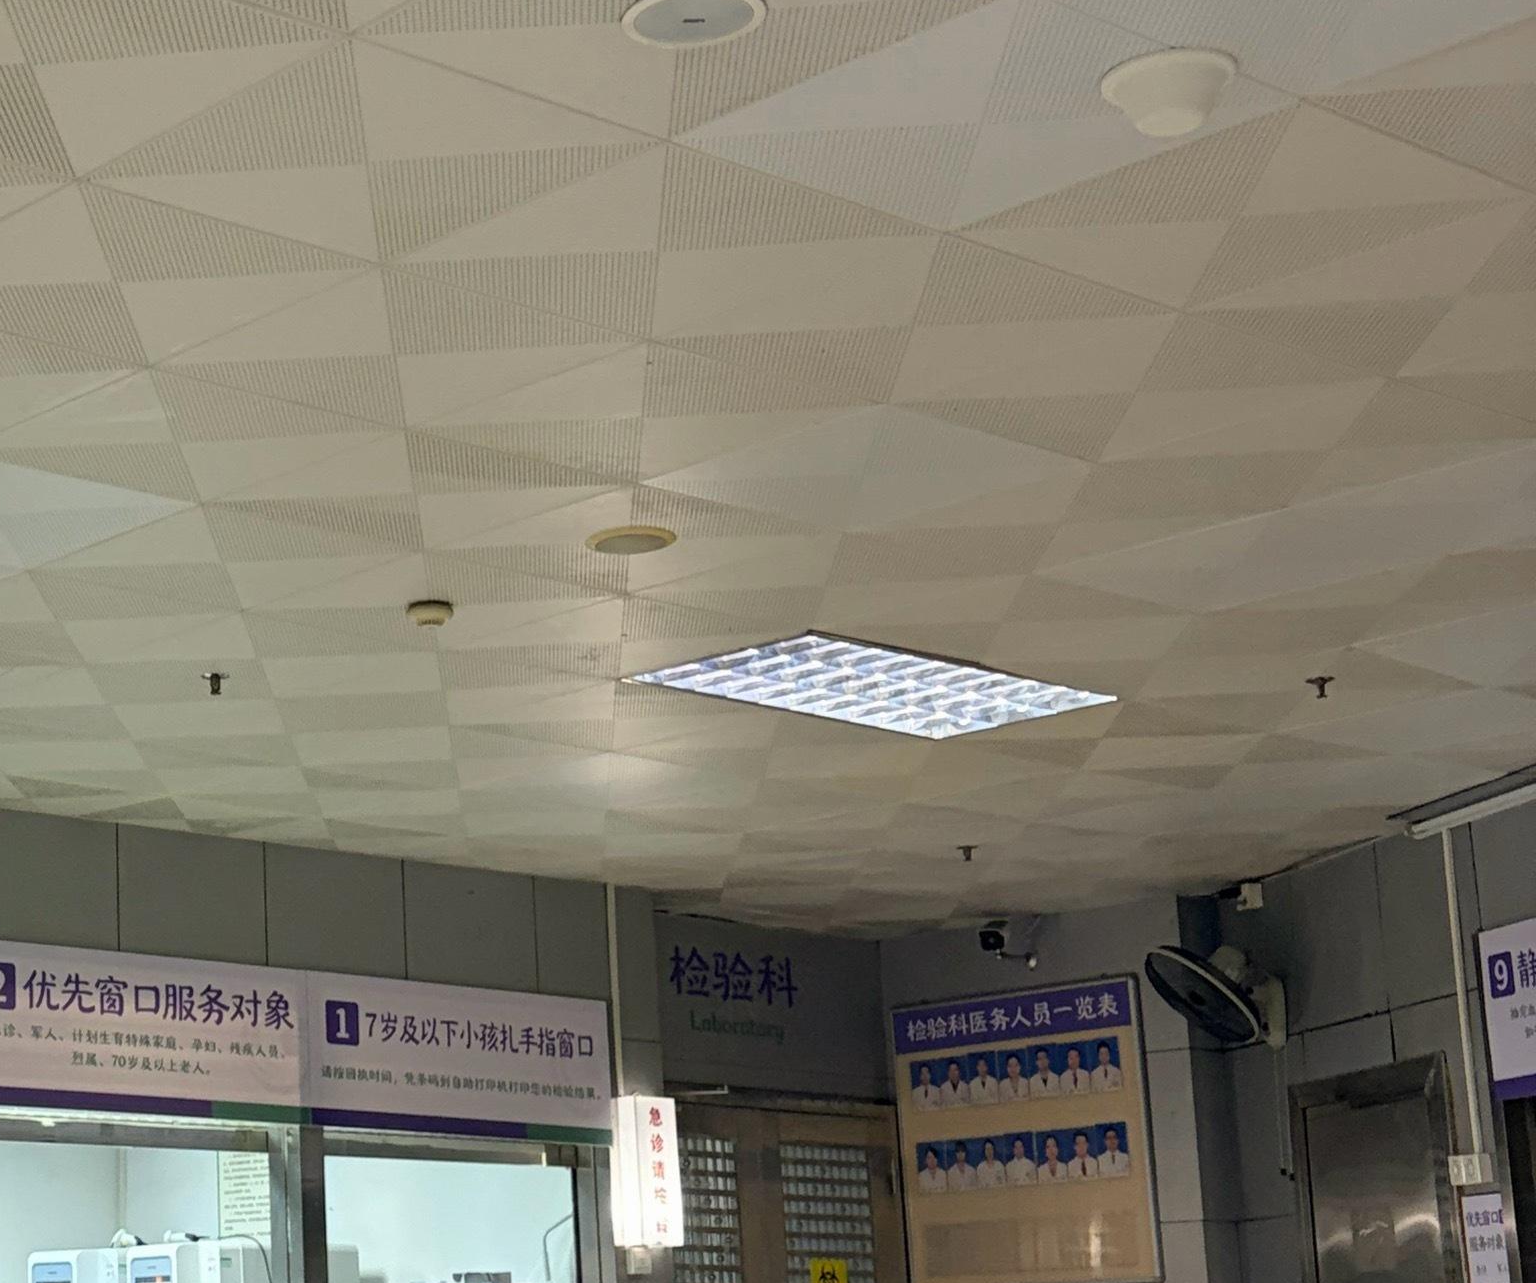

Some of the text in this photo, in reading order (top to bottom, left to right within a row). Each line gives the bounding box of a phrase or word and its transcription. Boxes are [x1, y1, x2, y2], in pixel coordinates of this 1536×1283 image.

[22, 969, 295, 1030] 优先窗口服务对象
[669, 945, 799, 1008] 检验科
[1494, 959, 1508, 991] 9
[336, 1007, 350, 1038] 1
[365, 1010, 593, 1059] 7岁及以下小孩扎手指窗口
[906, 992, 1118, 1042] 检验科医务人员一览表
